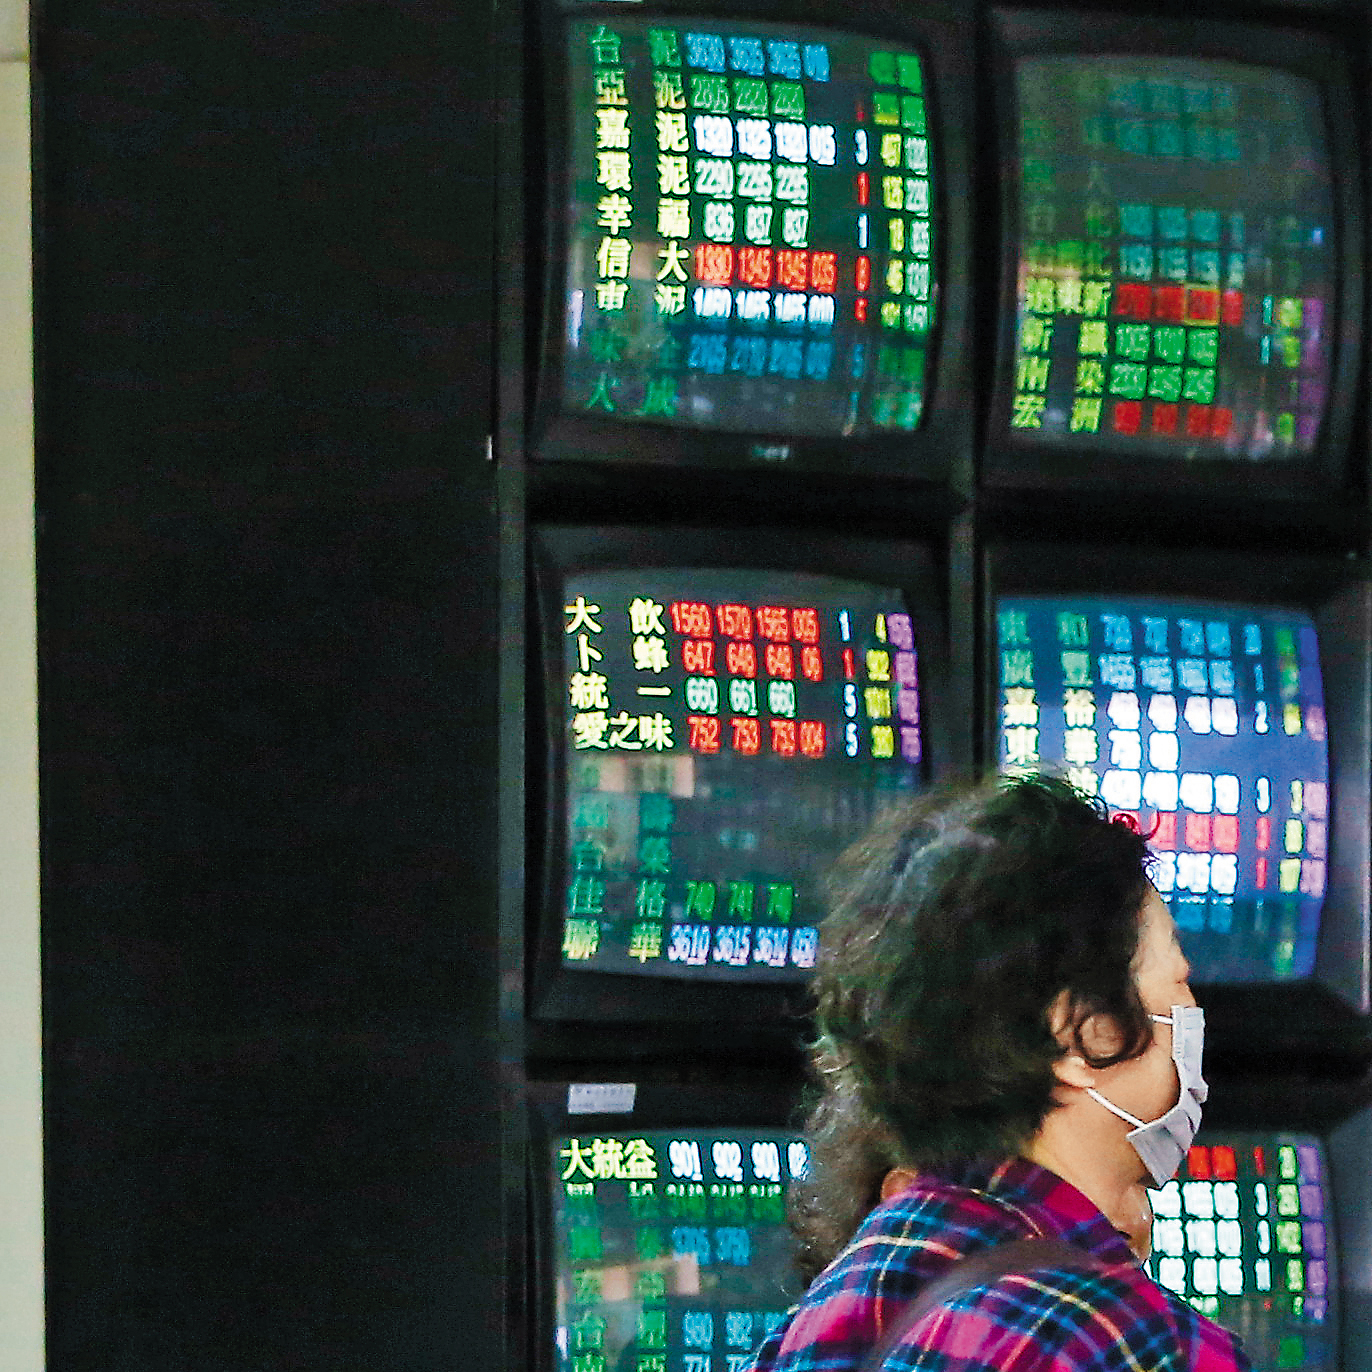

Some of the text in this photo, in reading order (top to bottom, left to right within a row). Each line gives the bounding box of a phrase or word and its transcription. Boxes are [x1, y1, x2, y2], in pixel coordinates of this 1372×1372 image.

[573, 712, 674, 752] 愛之味
[560, 1140, 657, 1180] 大統益
